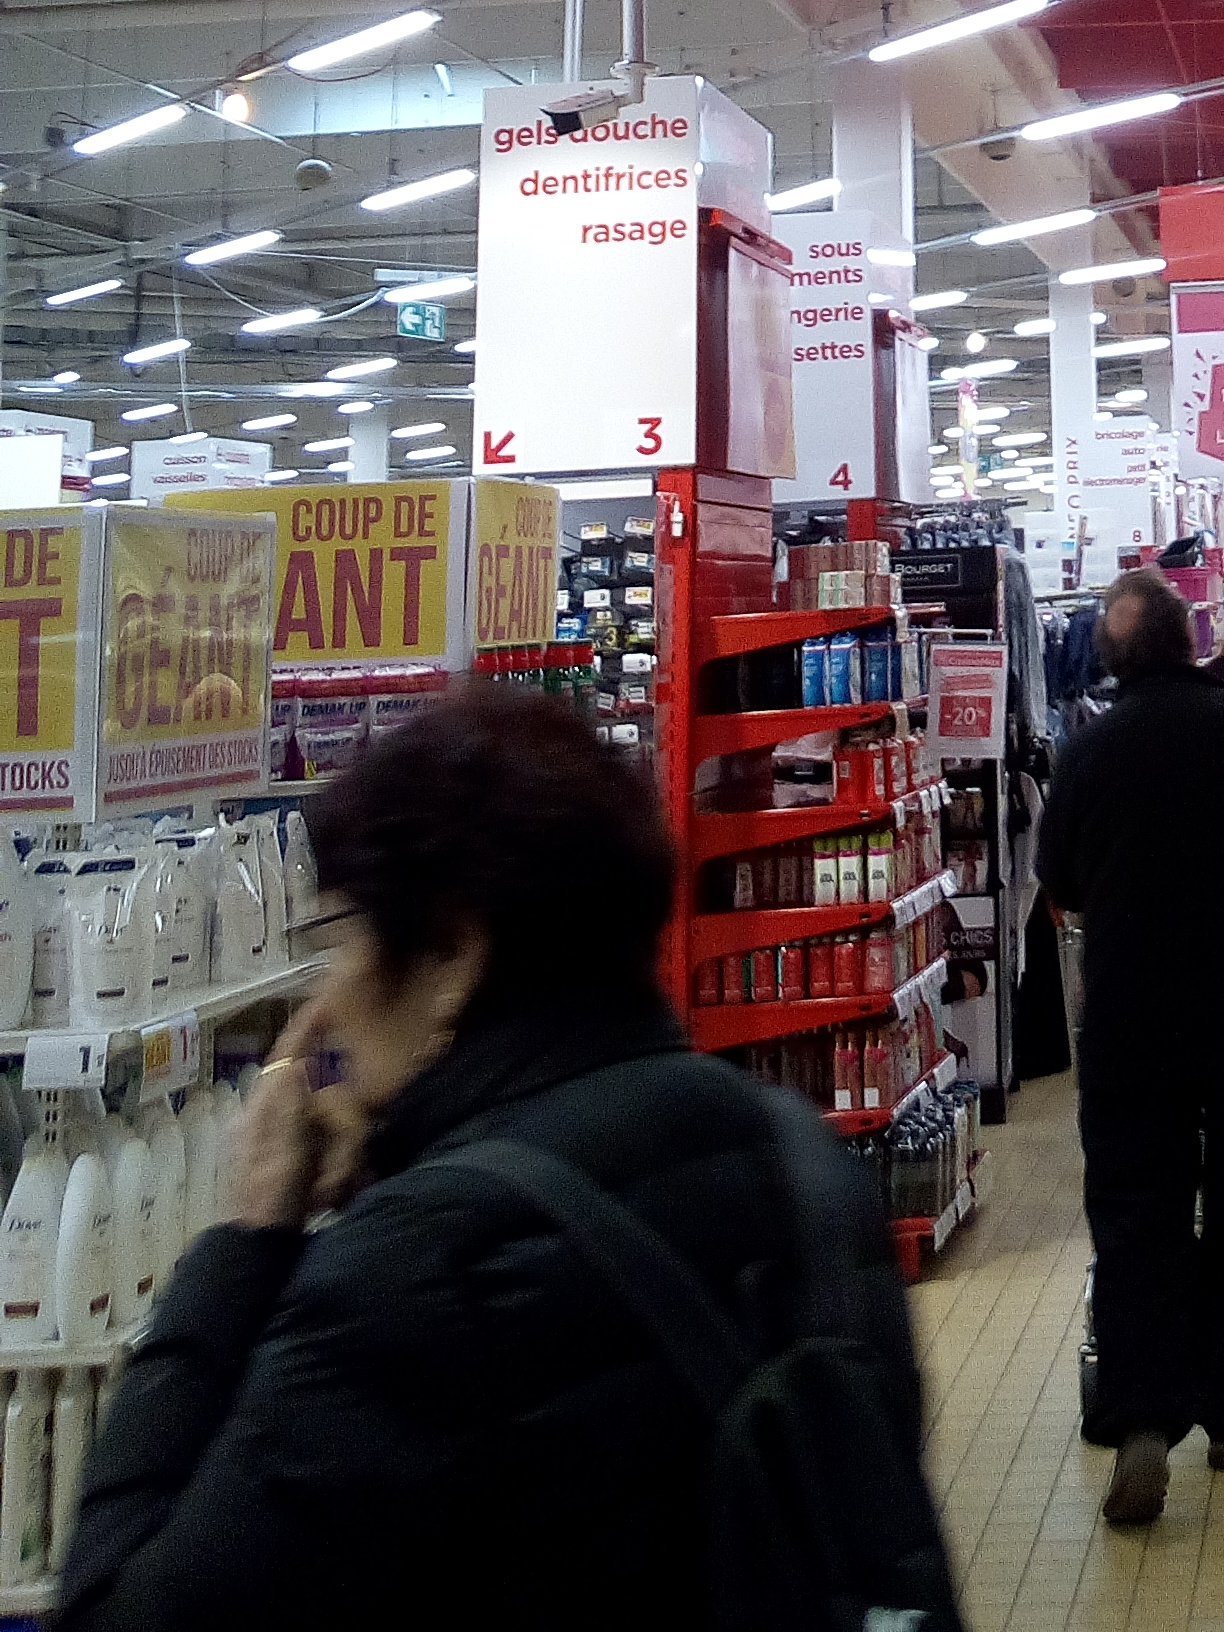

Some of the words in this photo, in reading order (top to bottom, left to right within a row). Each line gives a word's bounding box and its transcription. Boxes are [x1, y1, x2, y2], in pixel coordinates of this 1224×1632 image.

[494, 120, 559, 153] gels
[519, 165, 688, 196] dentifrices
[581, 219, 688, 245] rasage
[809, 241, 863, 258] sous
[789, 267, 863, 287] ments
[790, 302, 864, 328] ngerie
[793, 342, 865, 362] settes
[636, 416, 662, 455] 3
[162, 454, 208, 466] cuisson
[829, 463, 853, 491] 4
[291, 497, 383, 542] COUP
[393, 494, 437, 538] DE
[1132, 530, 1142, 542] 8
[4, 526, 65, 588] DE
[894, 563, 954, 574] BOURGET
[476, 523, 554, 643] GÉANT
[272, 545, 438, 651] ANT
[116, 566, 262, 731] GÉANT
[0, 759, 71, 792] TOCKS
